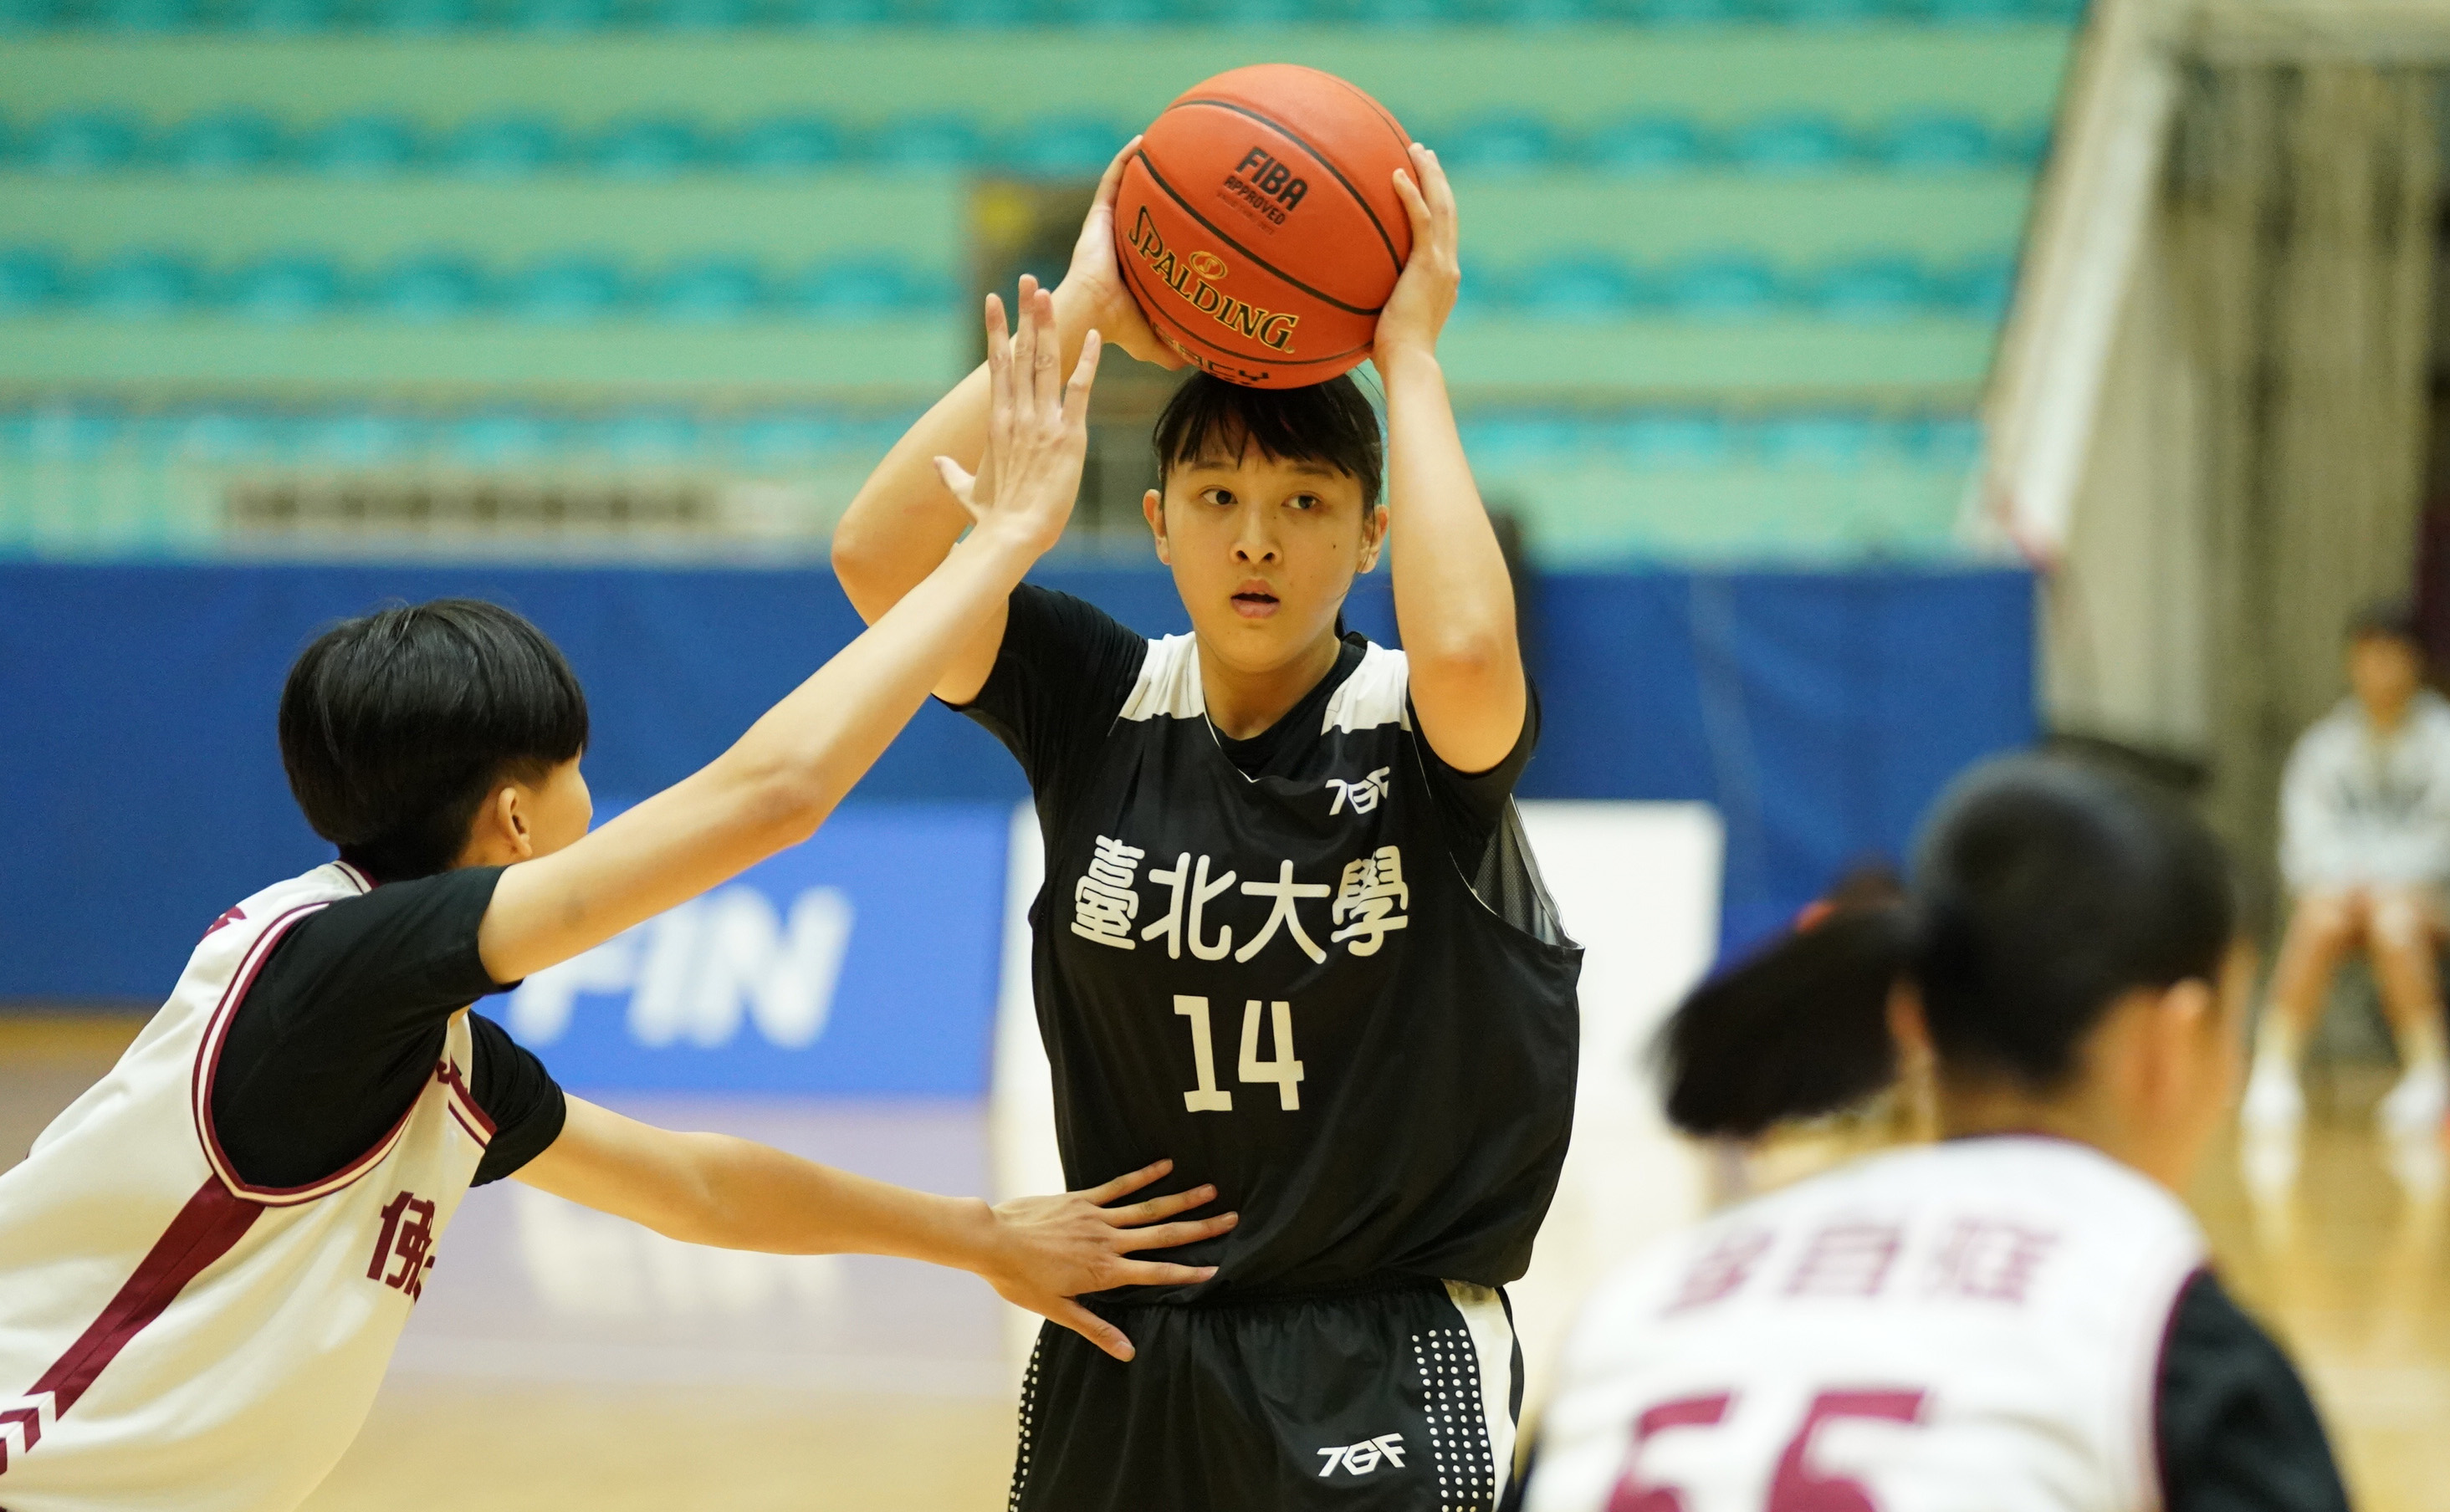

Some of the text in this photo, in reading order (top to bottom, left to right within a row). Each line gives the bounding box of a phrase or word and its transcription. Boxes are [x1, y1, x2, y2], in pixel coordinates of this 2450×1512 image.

[1224, 176, 1286, 225] APPROVED
[1235, 146, 1307, 211] FIBA
[1129, 206, 1299, 351] SPALDING
[1071, 835, 1409, 964] 臺北大學
[1174, 994, 1305, 1112] 14
[1317, 1433, 1406, 1477] TGF
